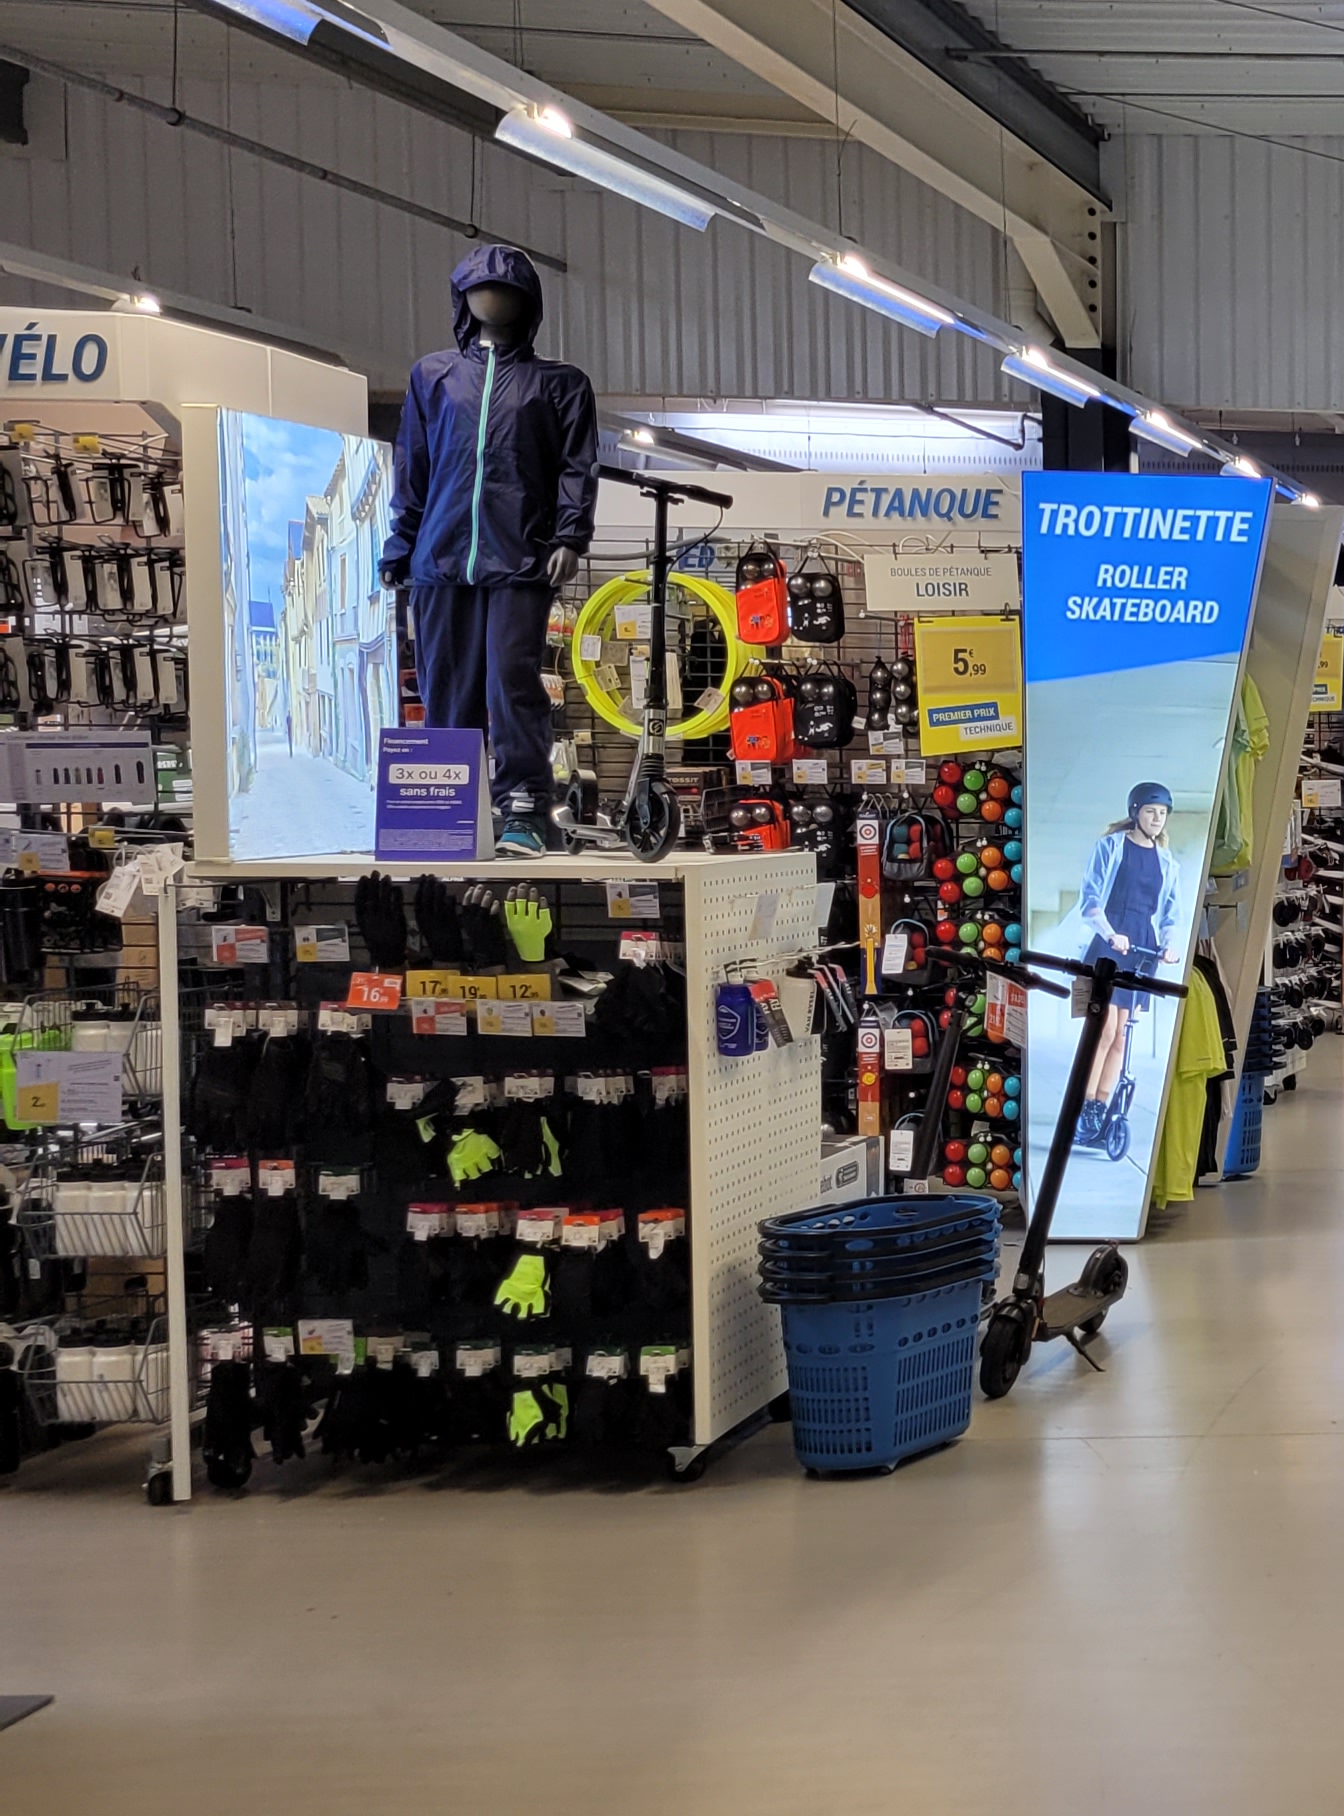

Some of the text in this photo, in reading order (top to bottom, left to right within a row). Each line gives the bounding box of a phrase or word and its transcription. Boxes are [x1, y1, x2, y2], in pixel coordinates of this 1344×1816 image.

[0, 321, 109, 383] ÉLO
[822, 480, 1004, 522] PÉTANQUE
[1038, 502, 1254, 543] TROTTINETTE
[889, 565, 993, 579] BOULES DE PÉTANQUE
[1096, 563, 1189, 591] ROLLER
[915, 582, 970, 598] LOISIR
[1065, 595, 1220, 624] SKATEBOARD
[932, 706, 996, 723] PREMIER PRIX
[963, 721, 1014, 736] TECHNIQUE
[395, 767, 462, 781] 3x ou 4x
[399, 785, 456, 798] sans frais
